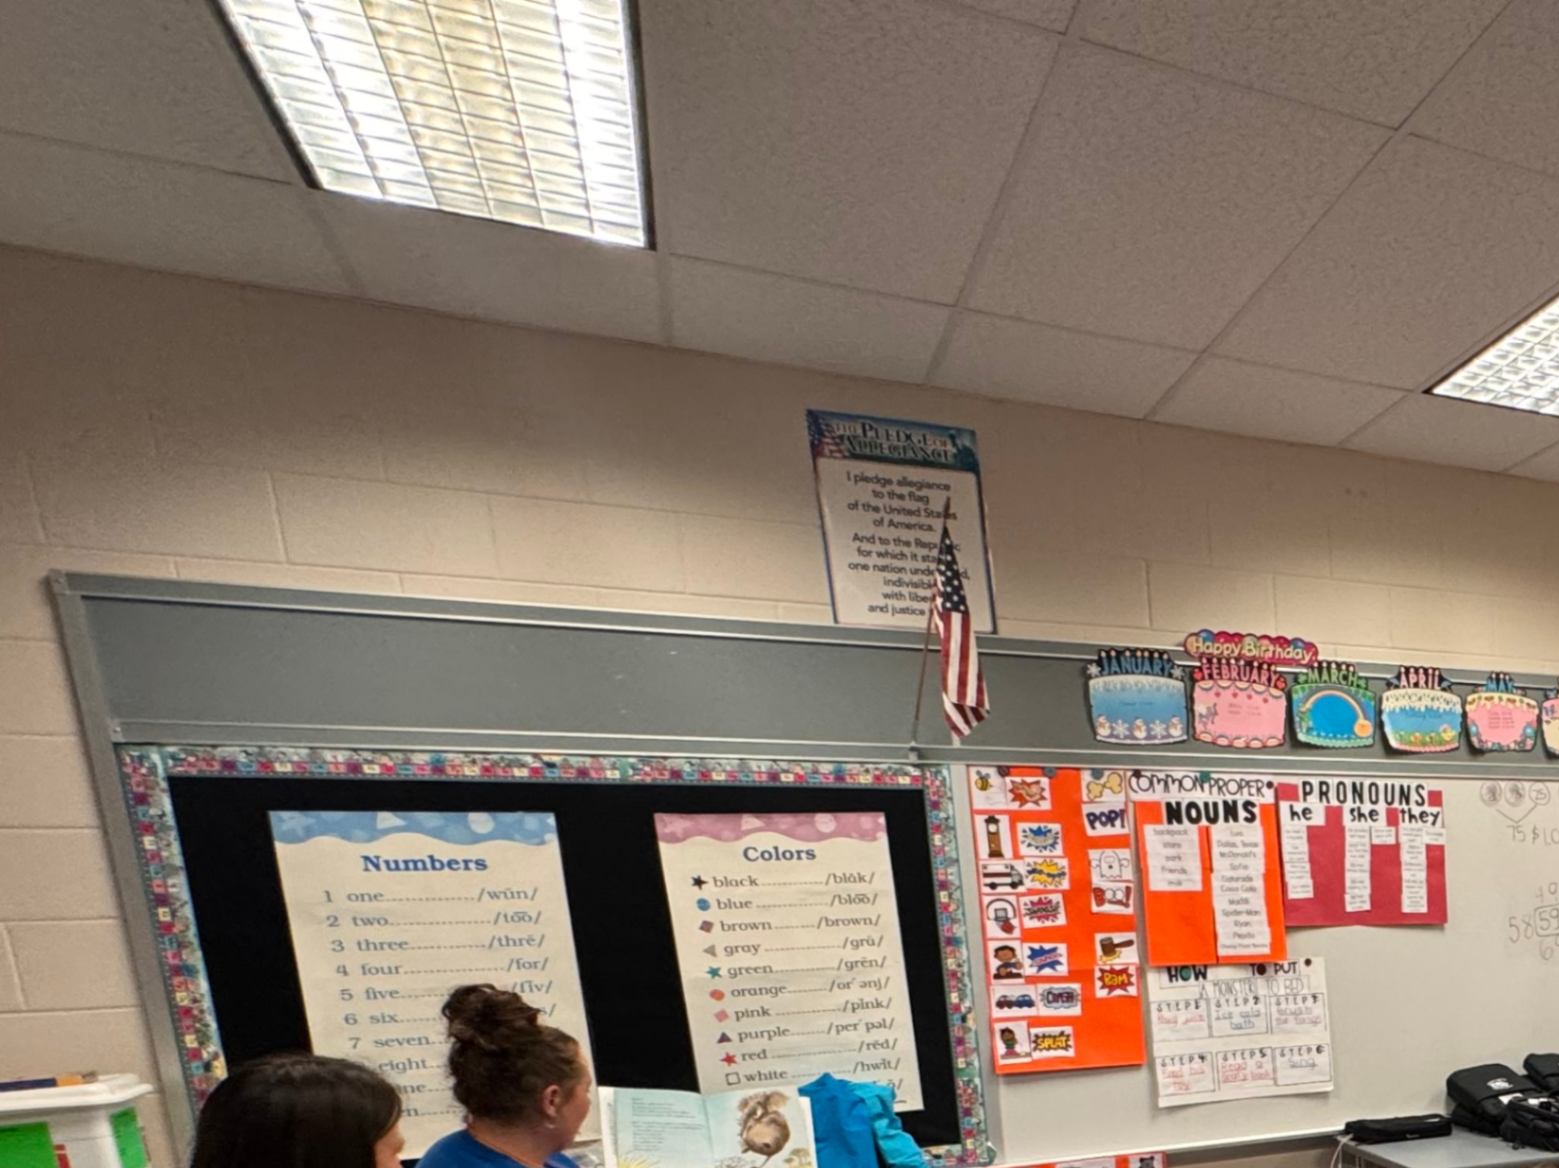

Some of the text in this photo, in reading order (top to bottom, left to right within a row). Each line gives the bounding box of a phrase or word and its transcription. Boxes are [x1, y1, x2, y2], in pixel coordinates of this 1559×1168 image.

[861, 422, 932, 446] PLEDGE
[854, 472, 894, 488] pledge
[896, 476, 951, 492] allegiance
[872, 491, 930, 506] to the flag
[848, 502, 921, 518] of the United
[873, 519, 936, 532] of America.
[852, 533, 912, 548] And to the
[858, 547, 908, 561] for which
[848, 564, 906, 576] one nation
[882, 591, 906, 602] with
[868, 604, 926, 617] and justice
[1191, 638, 1313, 663] Happy Birthday
[1100, 658, 1173, 677] JANUARY
[1202, 664, 1280, 686] FEBRUARY
[1307, 668, 1359, 686] MARCH
[1398, 673, 1440, 690] APRIL
[1486, 679, 1514, 692] MAY
[1129, 773, 1266, 798] COMMON PROPER
[1302, 782, 1427, 806] PRONOUNS
[1086, 809, 1126, 831] POP!
[1166, 801, 1258, 825] NOUNS
[1289, 805, 1441, 826] he she they
[743, 847, 817, 863] Colors
[361, 855, 488, 874] Numbers
[713, 875, 759, 888] black
[347, 892, 385, 903] one
[717, 898, 753, 910] blue
[326, 915, 389, 928] 2 two
[720, 919, 773, 932] brown
[331, 938, 409, 952] 3 three
[724, 942, 761, 957] gray
[336, 962, 403, 976] 4 four
[728, 964, 773, 979] green
[1274, 962, 1297, 974] PUT
[340, 987, 401, 1001] 5 five
[731, 984, 787, 999] orange
[1213, 979, 1304, 996] MONSTER BED
[344, 1012, 400, 1025] 6 six
[734, 1006, 771, 1022] pink
[348, 1035, 432, 1049] 7 seven
[737, 1026, 791, 1043] purple
[1037, 1035, 1069, 1049] SPLAT
[741, 1049, 768, 1062] red
[1222, 1051, 1256, 1062] STEP
[1279, 1047, 1312, 1057] STEP
[378, 1058, 429, 1074] eight
[744, 1069, 788, 1083] white
